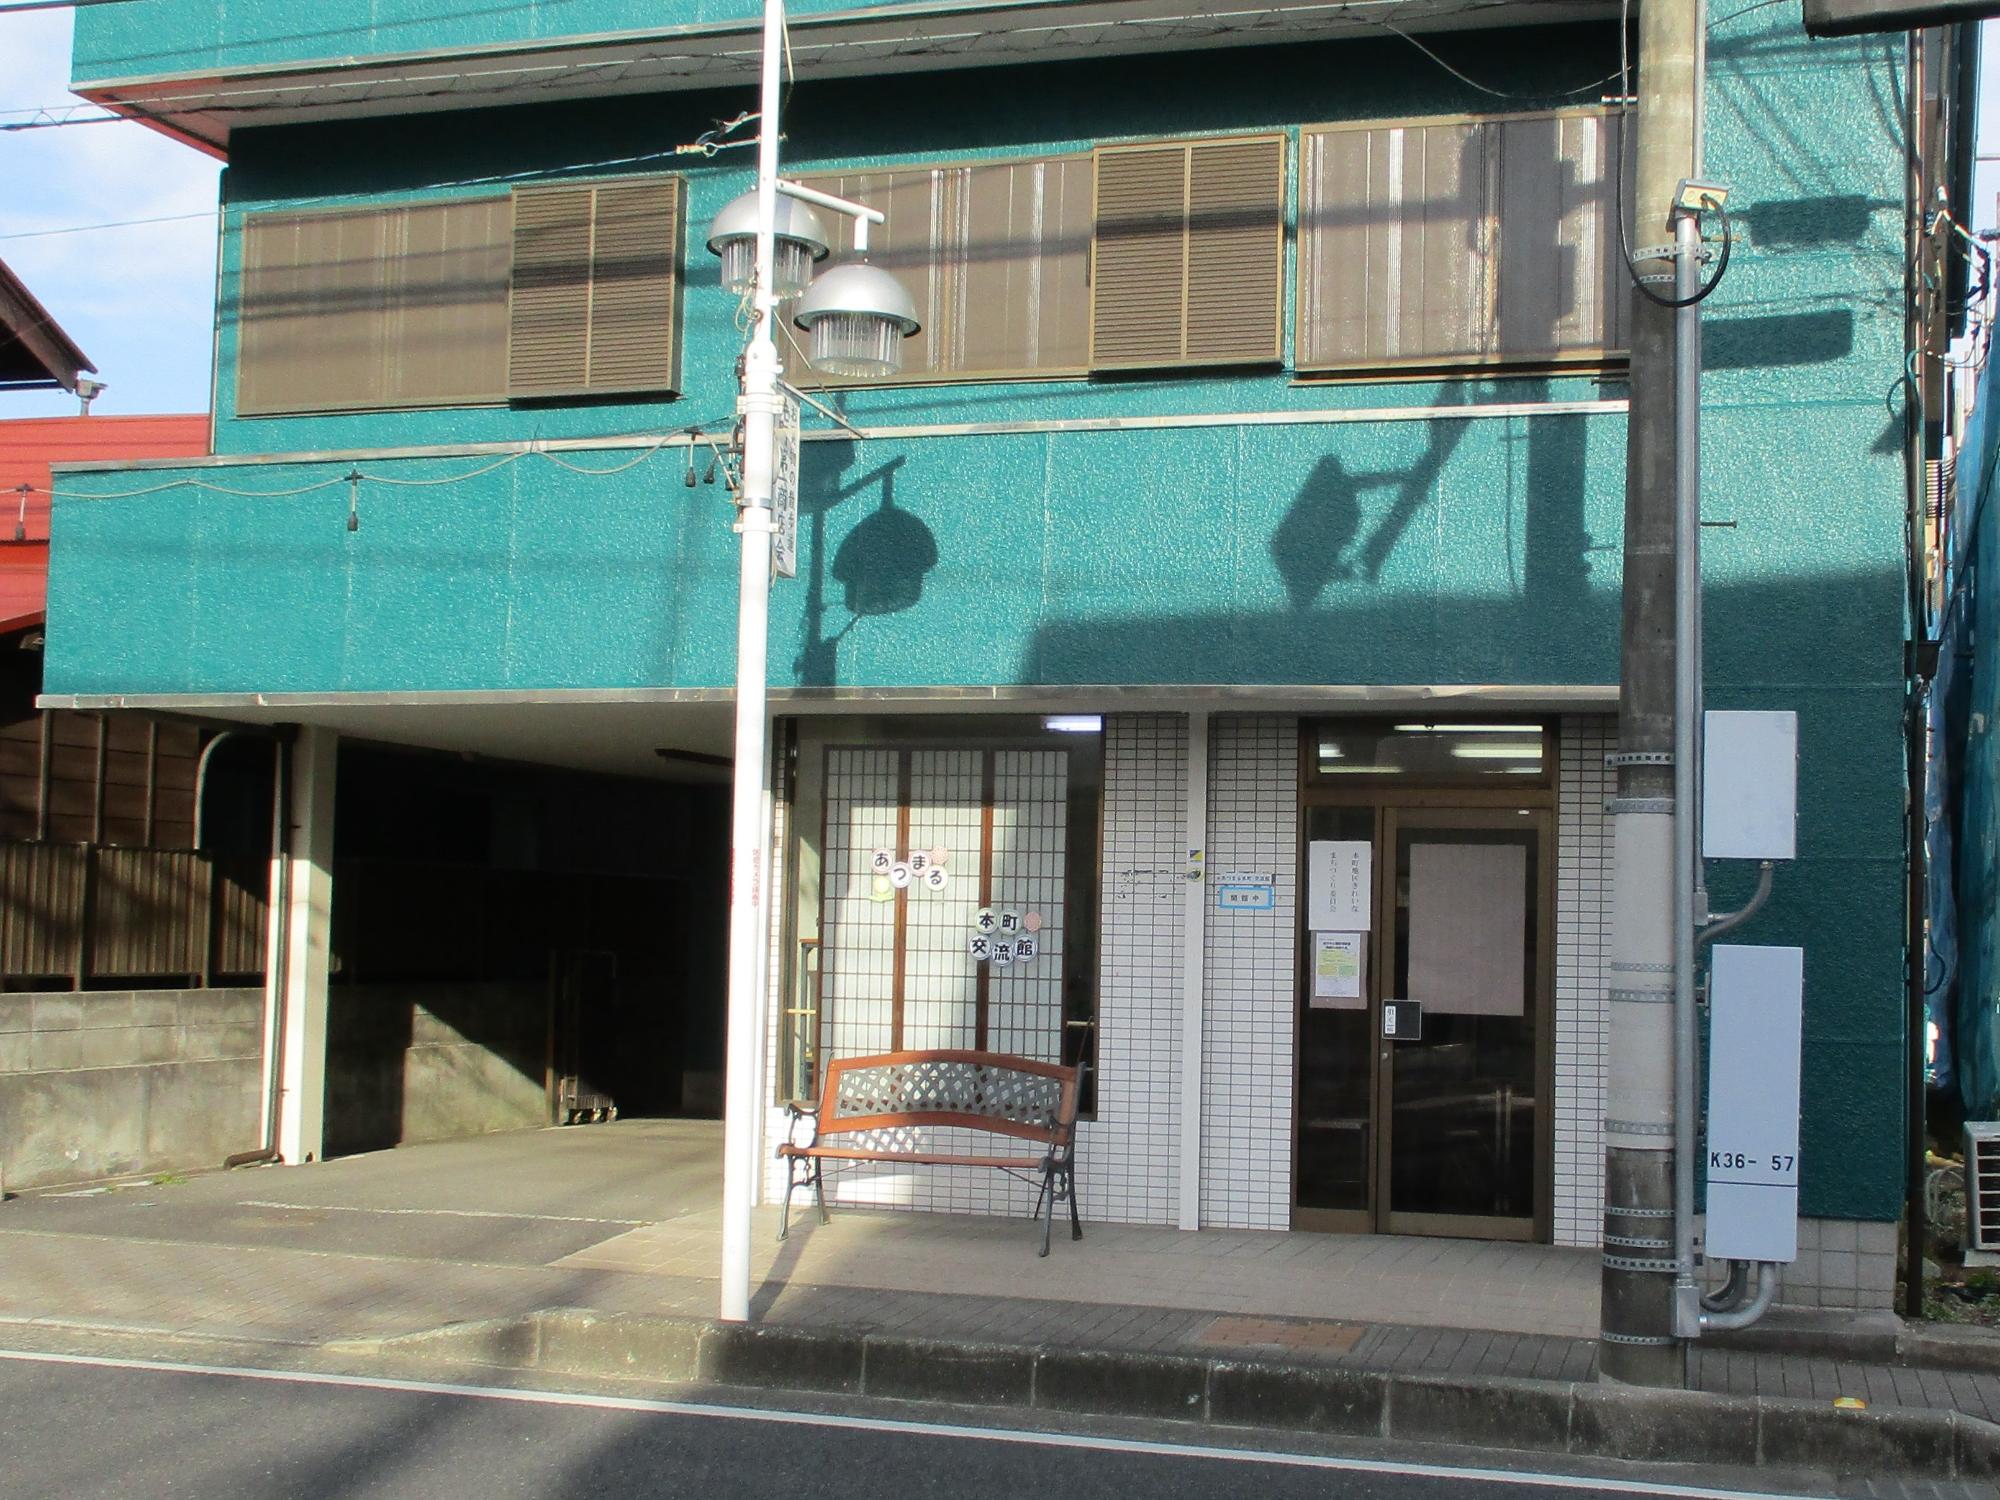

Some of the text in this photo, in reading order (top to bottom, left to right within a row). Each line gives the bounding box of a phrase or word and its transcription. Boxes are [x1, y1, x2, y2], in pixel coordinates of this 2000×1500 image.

[873, 852, 943, 885] あつまる
[979, 912, 1018, 931] 本町
[971, 938, 1034, 962] 交流館
[1771, 1155, 1794, 1172] 57
